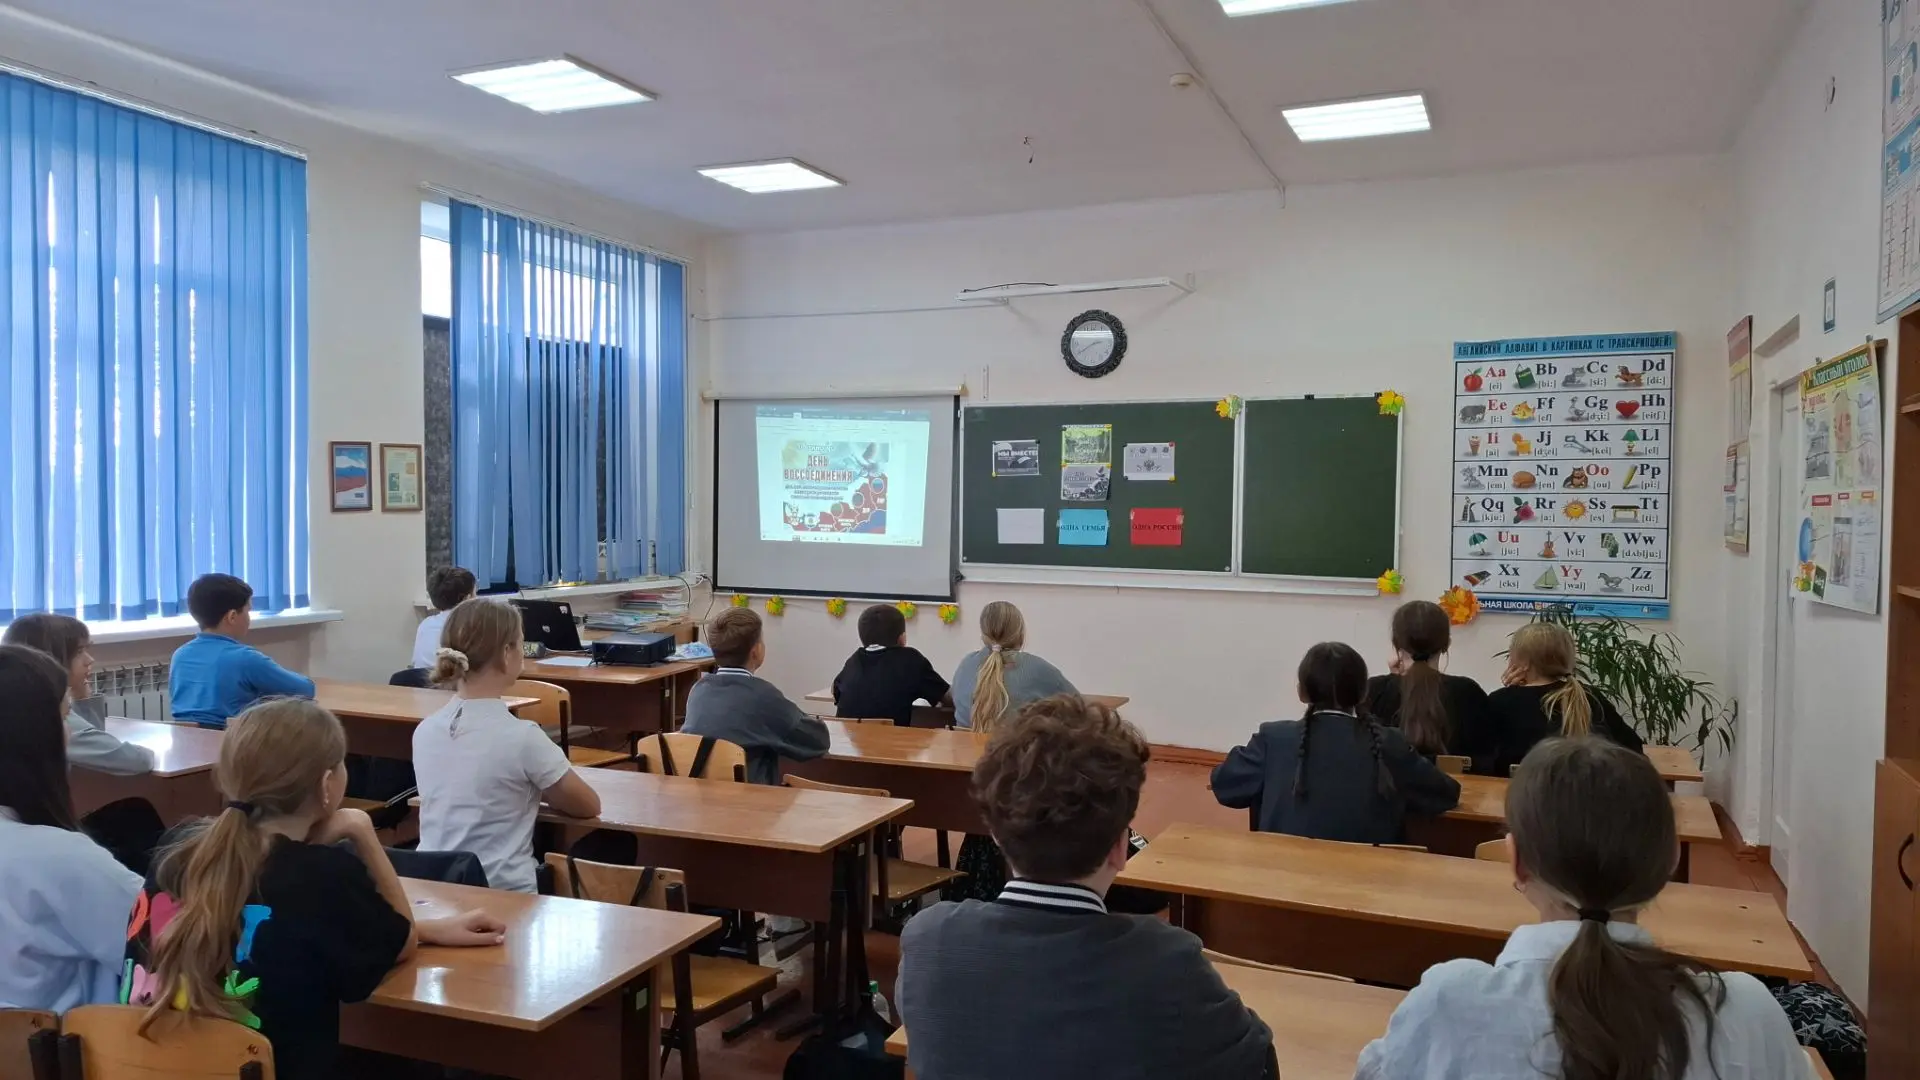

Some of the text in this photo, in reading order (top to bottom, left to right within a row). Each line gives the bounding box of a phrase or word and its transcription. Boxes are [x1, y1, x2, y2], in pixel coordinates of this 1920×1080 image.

[1536, 363, 1557, 375] Bb
[1586, 361, 1608, 373] Cc
[1642, 359, 1665, 371] Dd
[1485, 366, 1506, 377] Aa
[1488, 399, 1507, 410] Ee
[1537, 397, 1556, 409] Ff
[1585, 396, 1608, 410] Gg
[1642, 394, 1665, 406] Hh
[1488, 432, 1499, 443] Ii
[1536, 431, 1552, 445] Jj
[1585, 430, 1609, 441] Kk
[1641, 429, 1659, 441] Ll
[1478, 465, 1508, 476] Mm
[1536, 464, 1558, 476] Nn
[1586, 464, 1609, 476] Oo
[1638, 464, 1661, 479] Pp
[1481, 498, 1504, 512] Qq
[1535, 498, 1556, 509] Rr
[1588, 498, 1606, 509] Ss
[1640, 498, 1659, 509] Tt
[1498, 531, 1520, 543] Uu
[1564, 532, 1586, 544] Vv
[1624, 533, 1656, 545] Ww
[1498, 564, 1520, 576] Xx
[1560, 565, 1582, 580] Yy
[1631, 567, 1652, 580] Zz
[1478, 600, 1502, 609] ЬНАЯ
[1503, 601, 1534, 609] ШКОЛА
